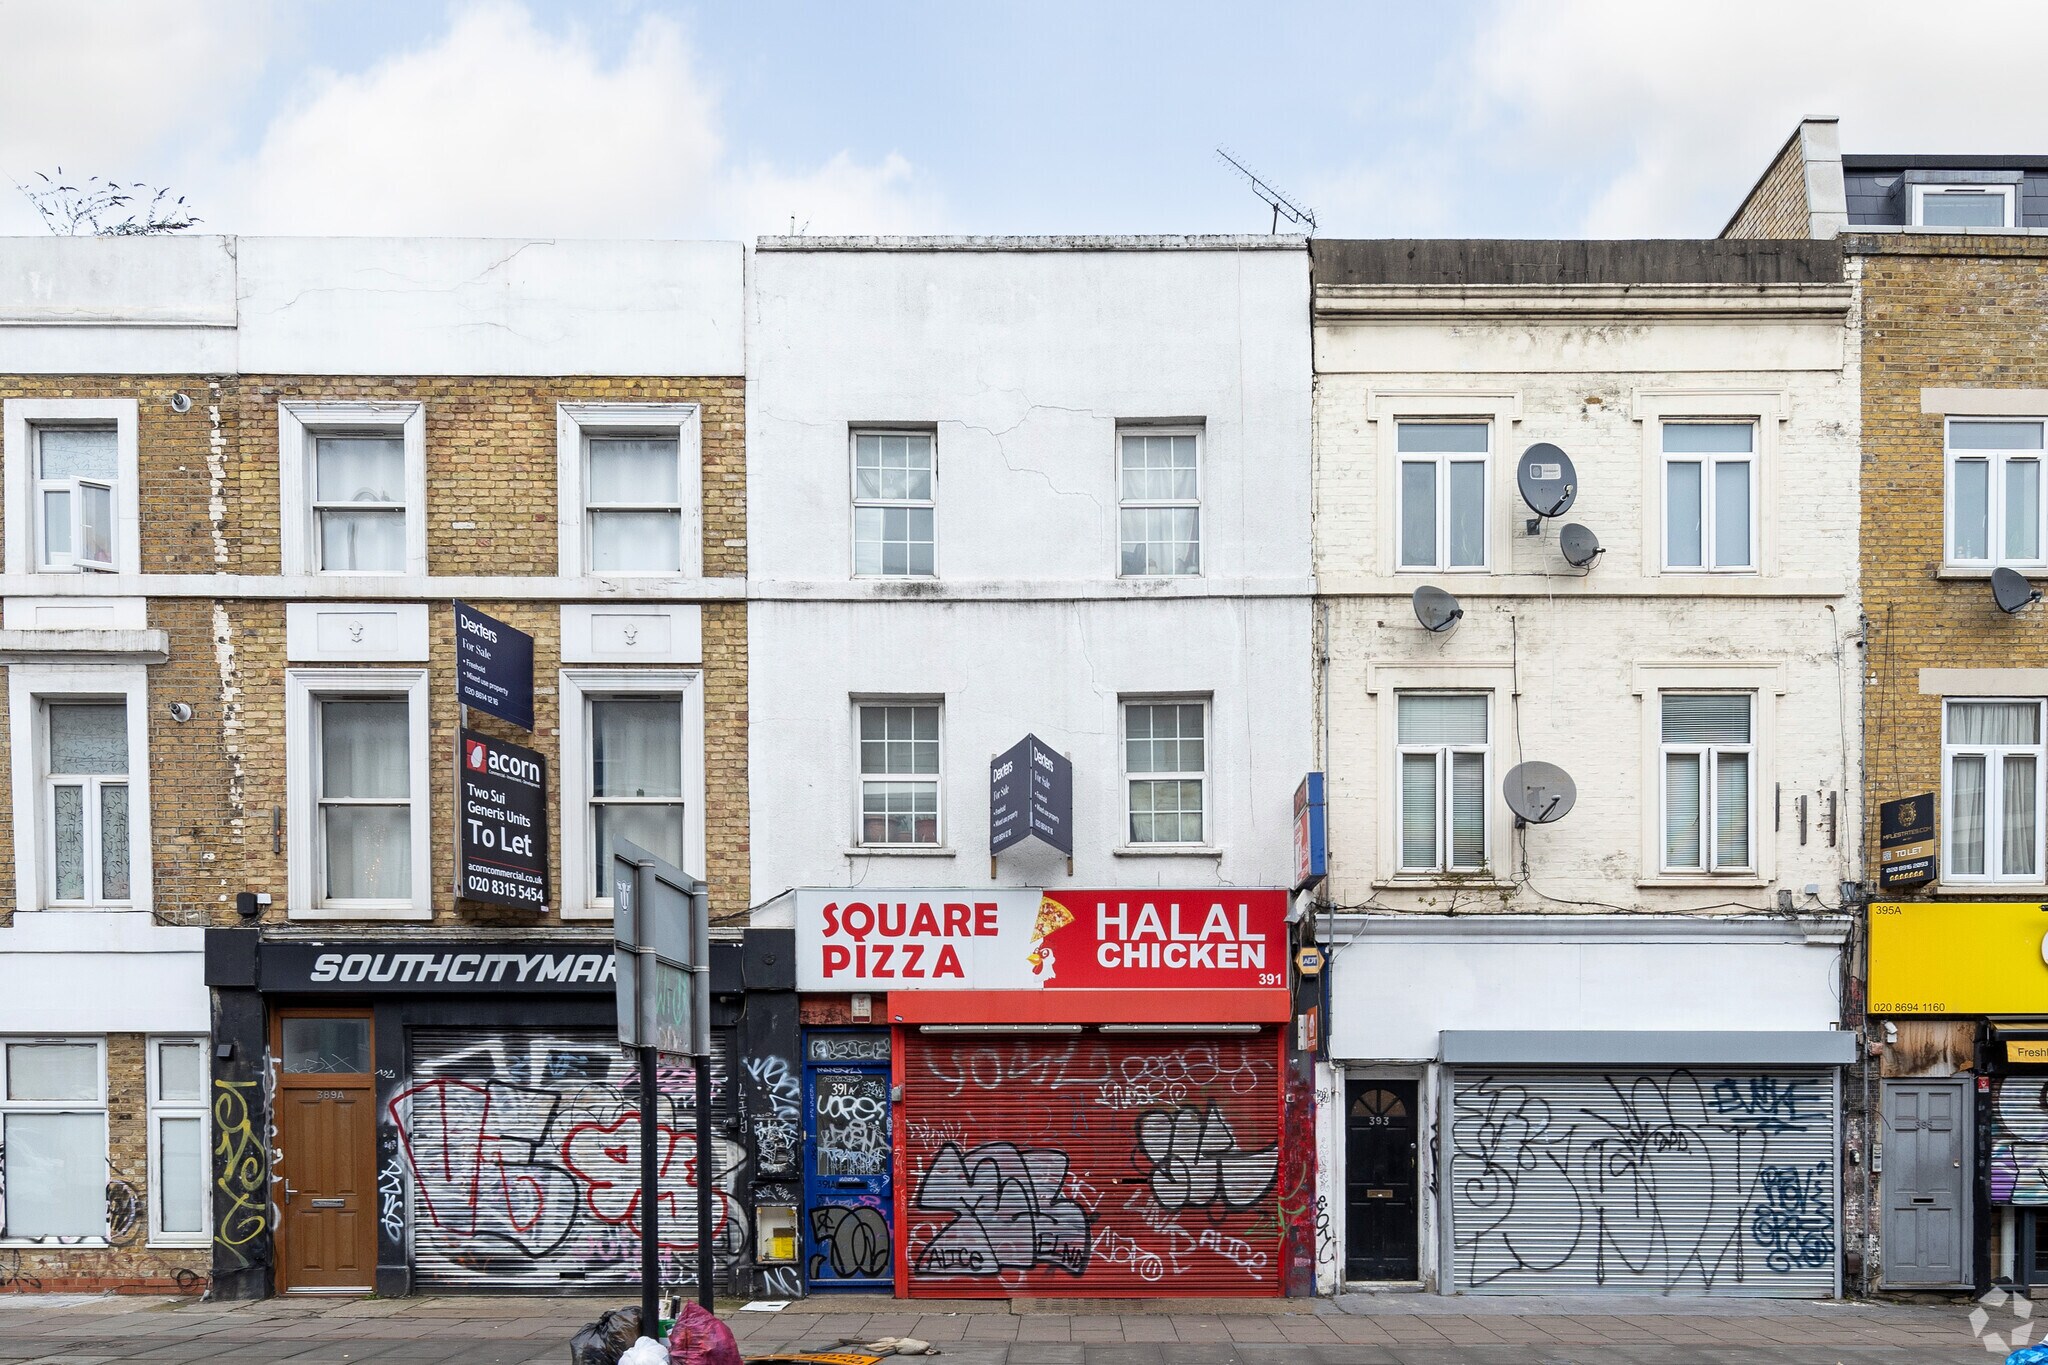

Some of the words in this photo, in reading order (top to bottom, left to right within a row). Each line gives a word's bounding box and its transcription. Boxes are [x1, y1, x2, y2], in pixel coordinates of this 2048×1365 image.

[460, 613, 498, 643] Dexters
[462, 637, 475, 653] For
[475, 645, 492, 660] Sale
[466, 658, 486, 674] Freehold
[467, 671, 481, 684] Mixed
[480, 678, 489, 688] use
[489, 681, 509, 697] property
[488, 750, 540, 783] acorn
[1033, 746, 1054, 773] Dexters
[993, 760, 1014, 783] Dexters
[467, 782, 489, 800] Two
[490, 789, 506, 805] Sui
[467, 800, 505, 821] Generis
[506, 810, 531, 827] Units
[467, 818, 495, 848] To
[500, 826, 533, 857] Let
[1895, 849, 1907, 858] TO
[1907, 846, 1923, 856] LET
[467, 863, 543, 885] acorncommercial.co.uk
[468, 875, 490, 893] 020
[491, 880, 517, 898] 8315
[518, 884, 544, 903] 5454
[1875, 905, 1902, 915] 395A
[821, 902, 999, 942] SQUARE
[1096, 902, 1266, 942] HALAL
[822, 944, 965, 978] PIZZA
[1096, 942, 1266, 969] CHICKEN
[1303, 956, 1317, 965] ADT
[1258, 973, 1282, 985] 391
[1873, 1002, 1892, 1012] 020
[1894, 1002, 1919, 1012] 8694
[1922, 1002, 1946, 1012] 1160
[2018, 1047, 2048, 1057] Fresh
[317, 1090, 345, 1099] 389A
[1369, 1116, 1390, 1126] 393
